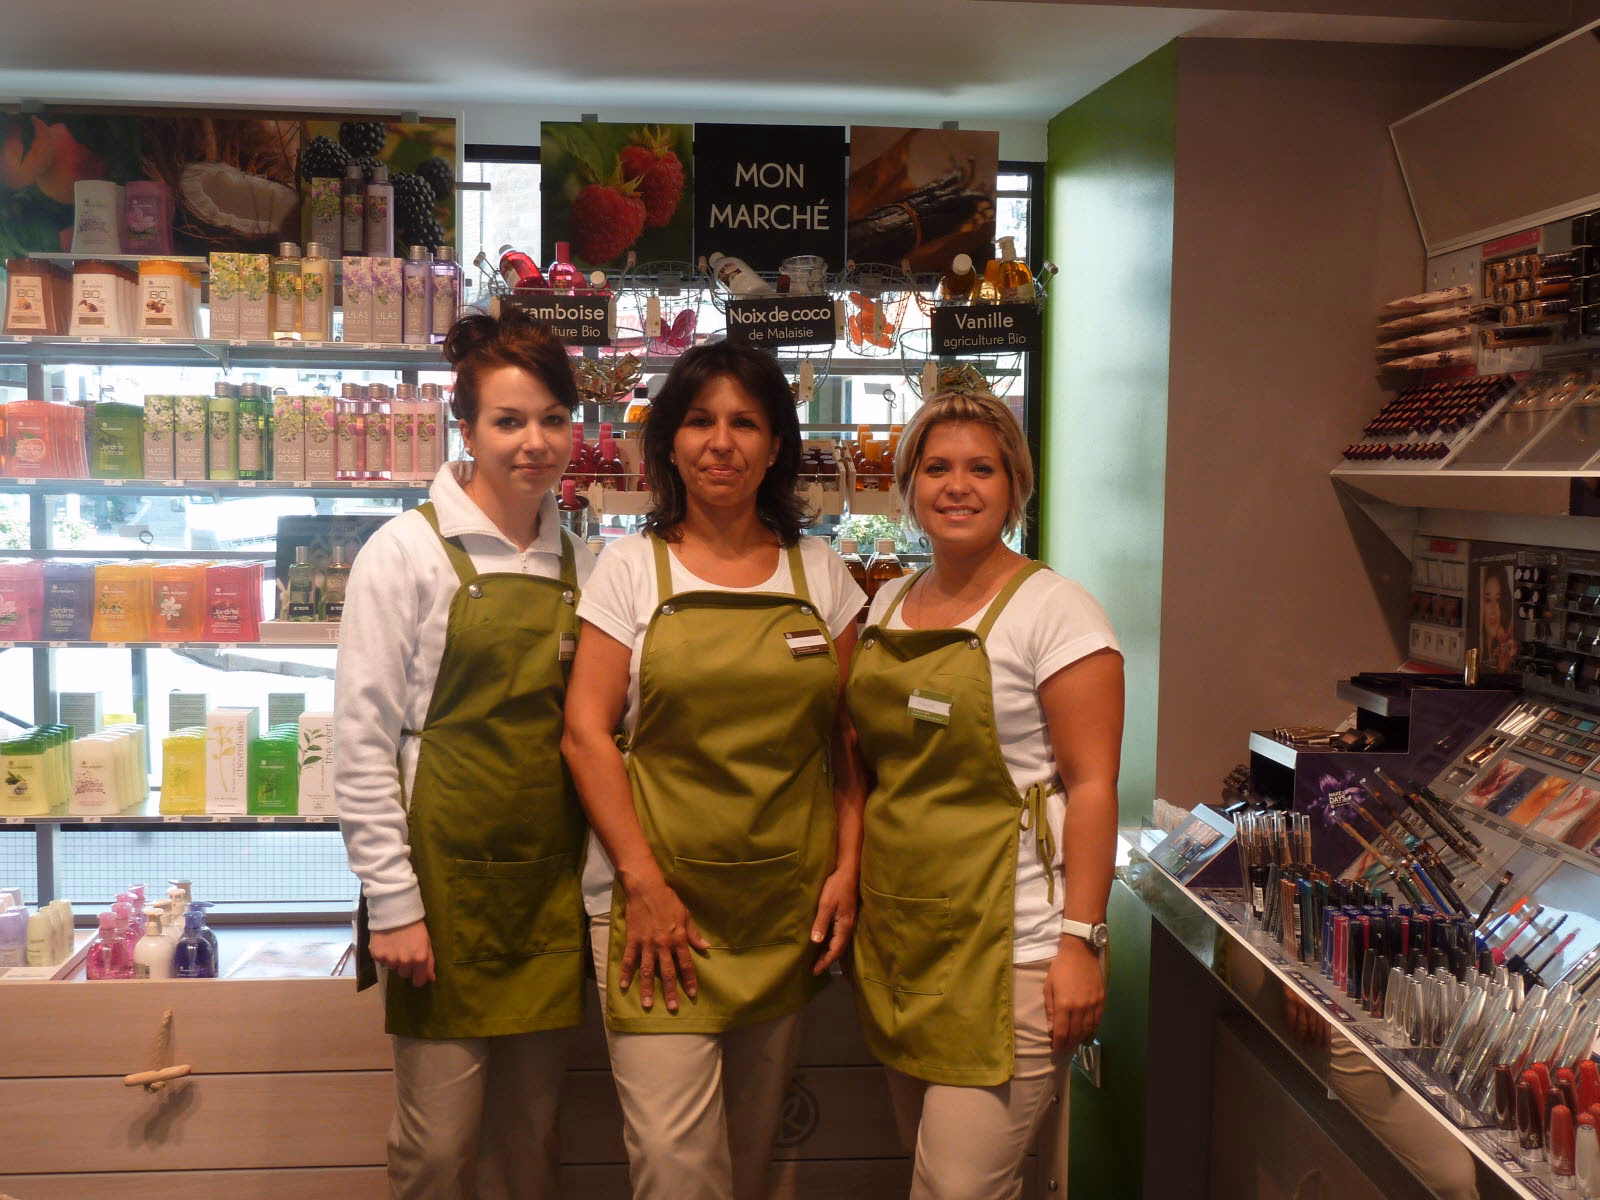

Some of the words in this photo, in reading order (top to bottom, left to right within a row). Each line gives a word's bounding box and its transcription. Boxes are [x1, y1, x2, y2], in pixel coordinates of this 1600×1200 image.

[735, 162, 804, 188] MON
[709, 198, 830, 230] MARCHÉ
[346, 311, 369, 319] LILAS
[376, 311, 398, 320] LILAS
[729, 307, 767, 324] Noix
[768, 306, 789, 322] de
[791, 308, 831, 321] coco
[954, 312, 1014, 330] Vanille
[582, 325, 600, 337] Bio
[748, 329, 764, 340] de
[767, 327, 814, 339] Malaisie
[943, 334, 1005, 349] agriculture
[1008, 332, 1027, 345] Bio
[278, 455, 300, 463] ROSE
[324, 724, 333, 744] vert
